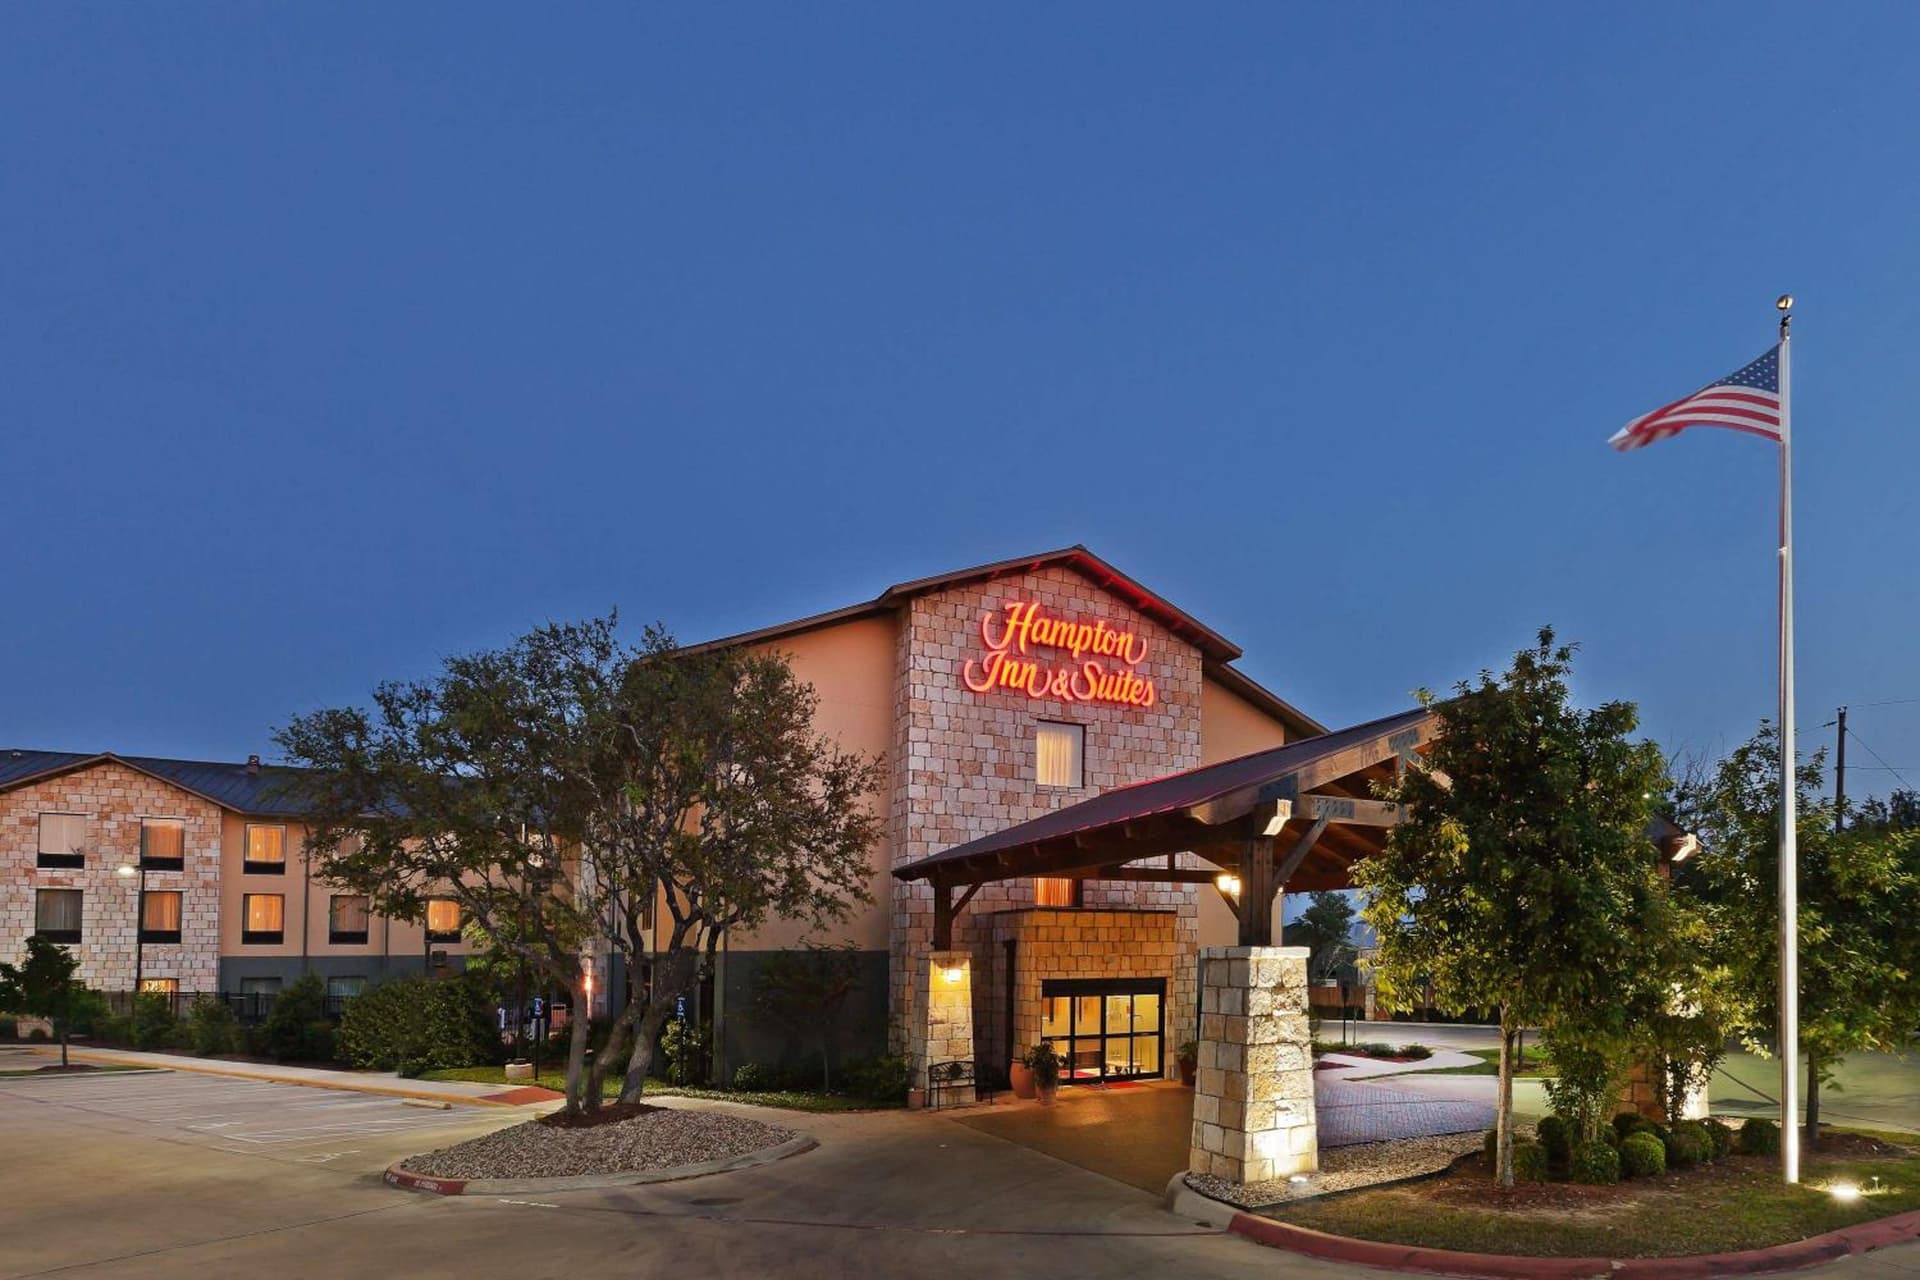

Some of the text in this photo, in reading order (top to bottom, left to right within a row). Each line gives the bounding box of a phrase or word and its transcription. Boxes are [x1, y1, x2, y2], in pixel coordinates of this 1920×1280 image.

[982, 602, 1148, 664] Hampton
[963, 650, 1155, 707] Inn & Suites
